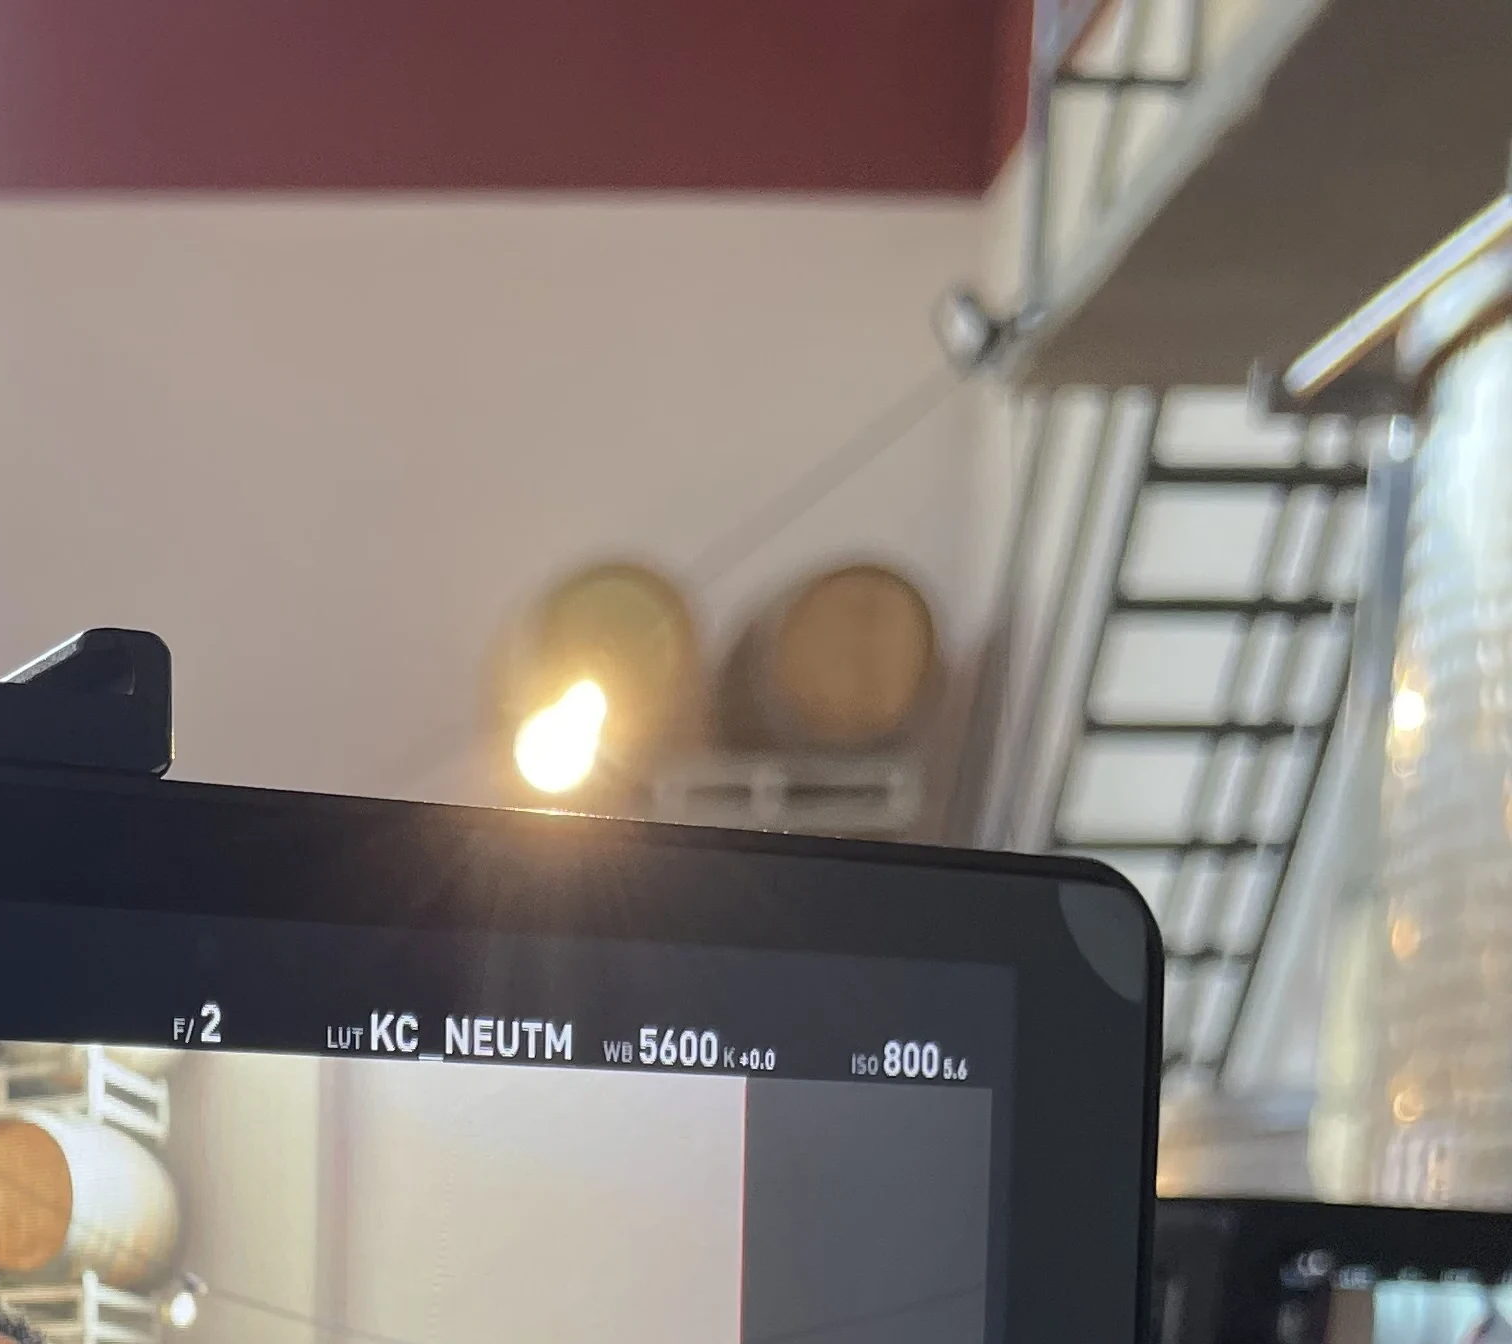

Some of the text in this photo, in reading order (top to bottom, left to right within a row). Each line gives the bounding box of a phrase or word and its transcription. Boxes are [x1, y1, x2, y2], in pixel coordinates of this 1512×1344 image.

[327, 1026, 364, 1050] LUT
[603, 1040, 633, 1064] WB
[639, 1028, 719, 1068] 5600
[851, 1053, 879, 1077] ISO
[883, 1040, 939, 1079] 800
